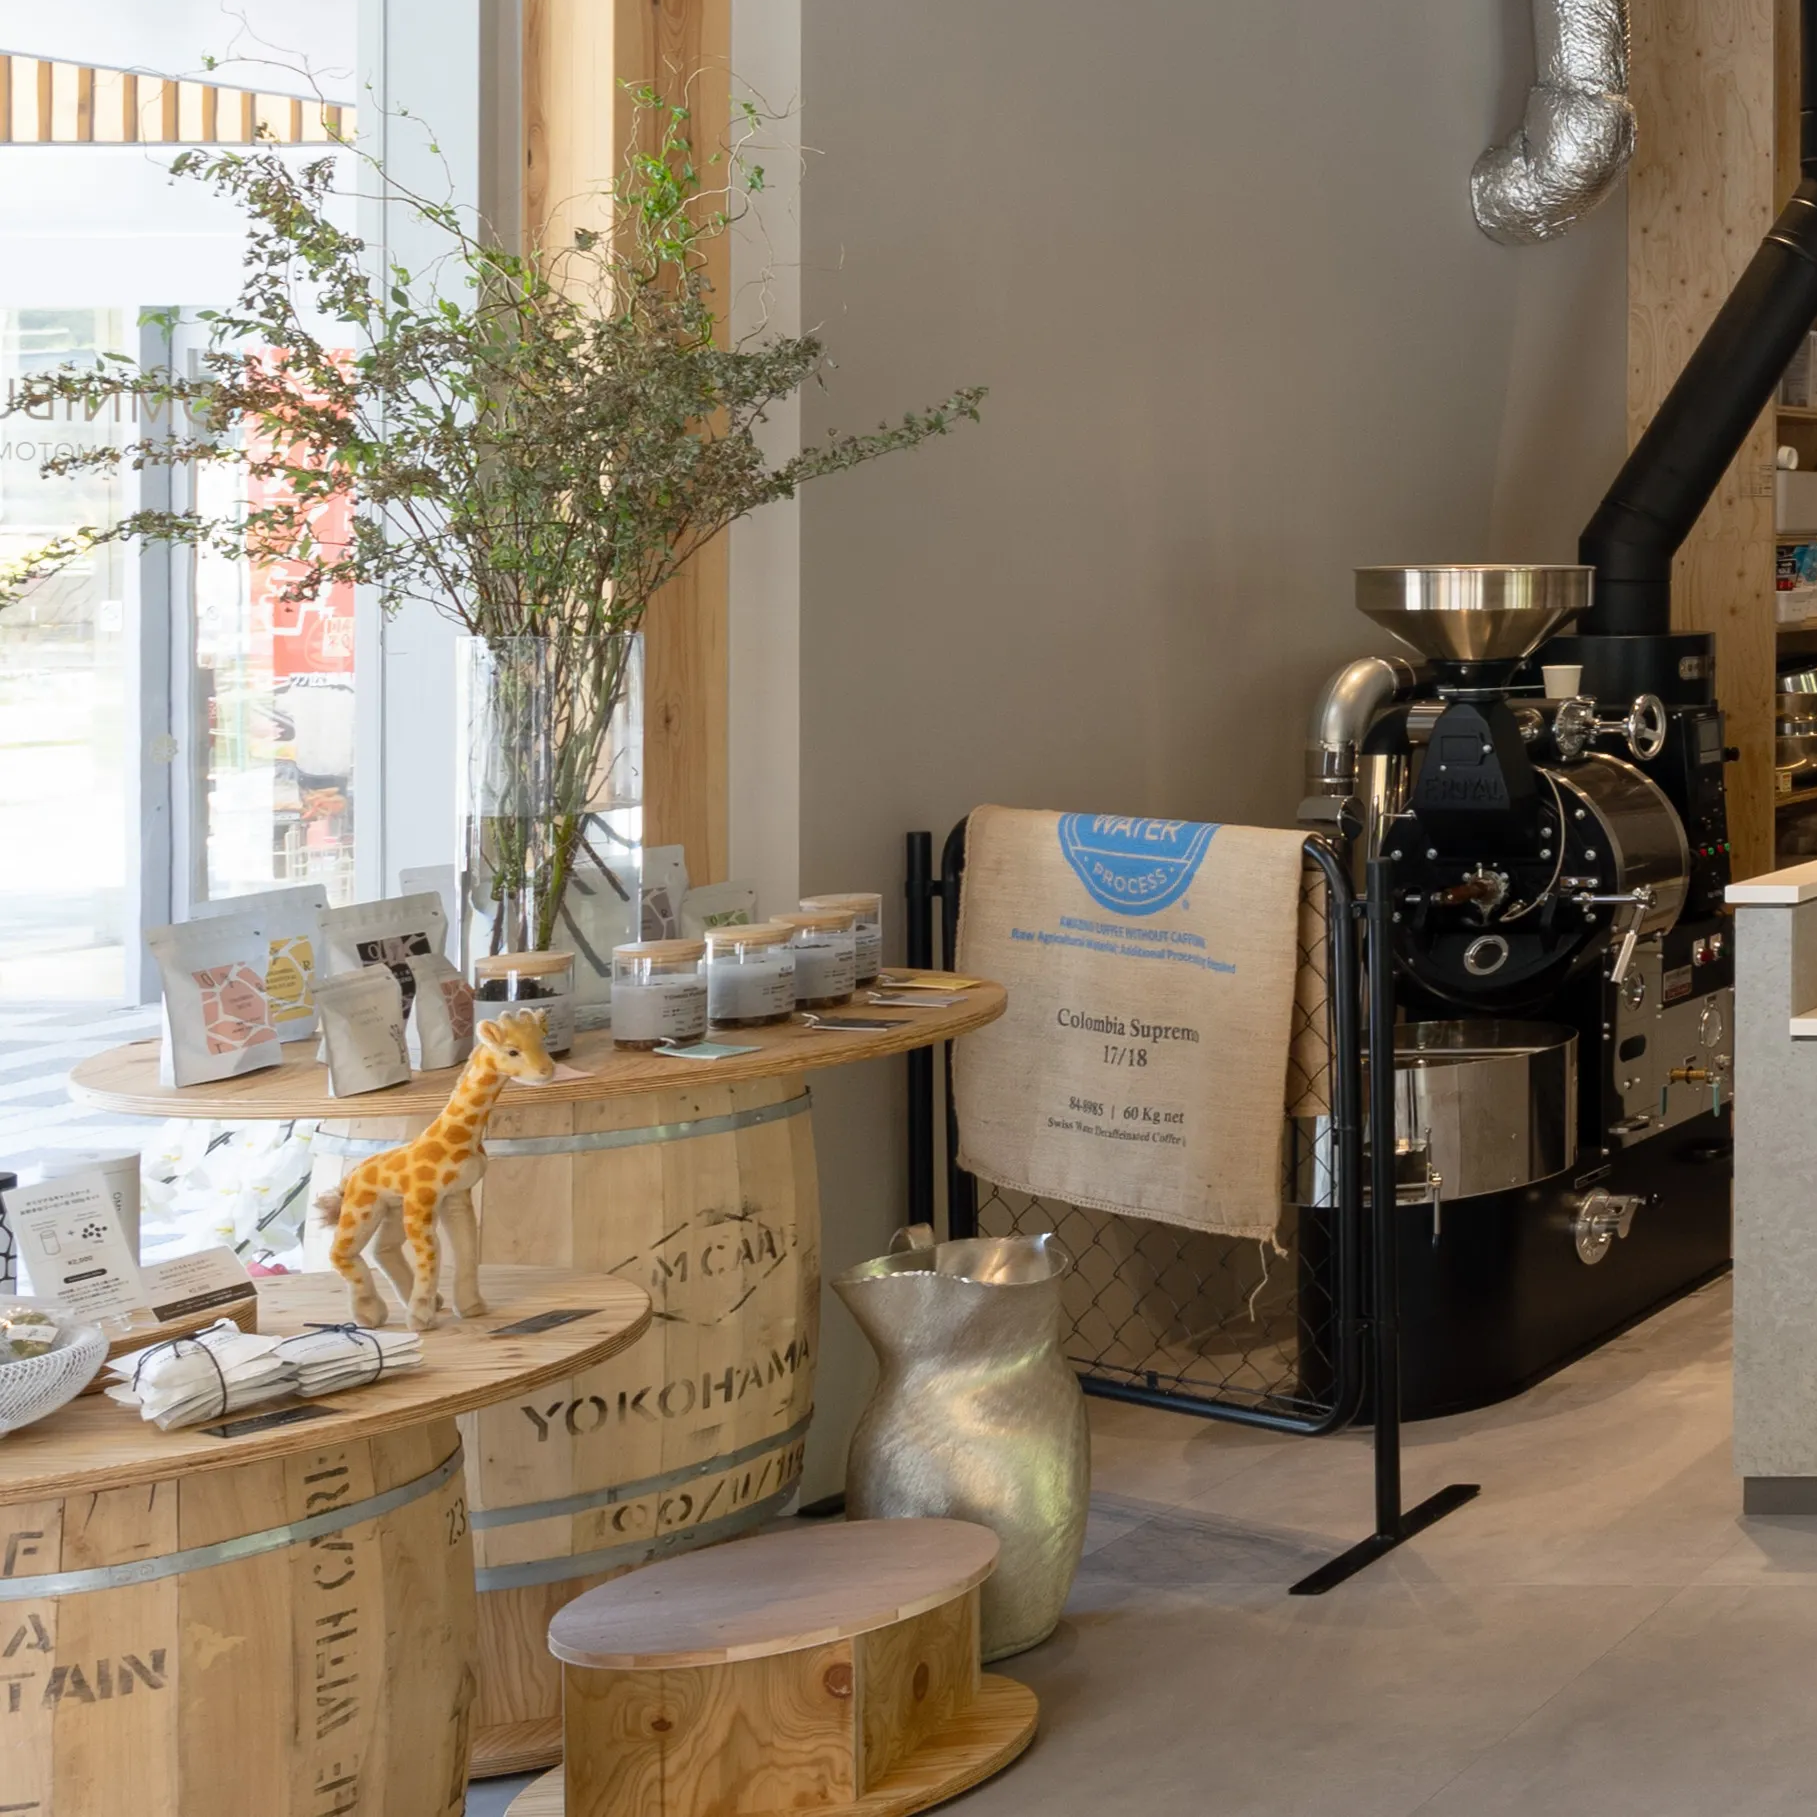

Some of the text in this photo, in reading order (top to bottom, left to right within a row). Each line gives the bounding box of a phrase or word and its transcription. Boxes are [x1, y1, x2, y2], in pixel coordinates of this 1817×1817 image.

[1092, 814, 1183, 843] WATER
[1093, 861, 1168, 895] PROCESS
[1057, 1008, 1126, 1036] Colombia
[1103, 1044, 1148, 1068] 17/18
[1123, 1105, 1139, 1121] 60
[1142, 1107, 1161, 1125] Kg
[1164, 1112, 1184, 1125] net
[520, 1335, 810, 1443] YOKOHAMA
